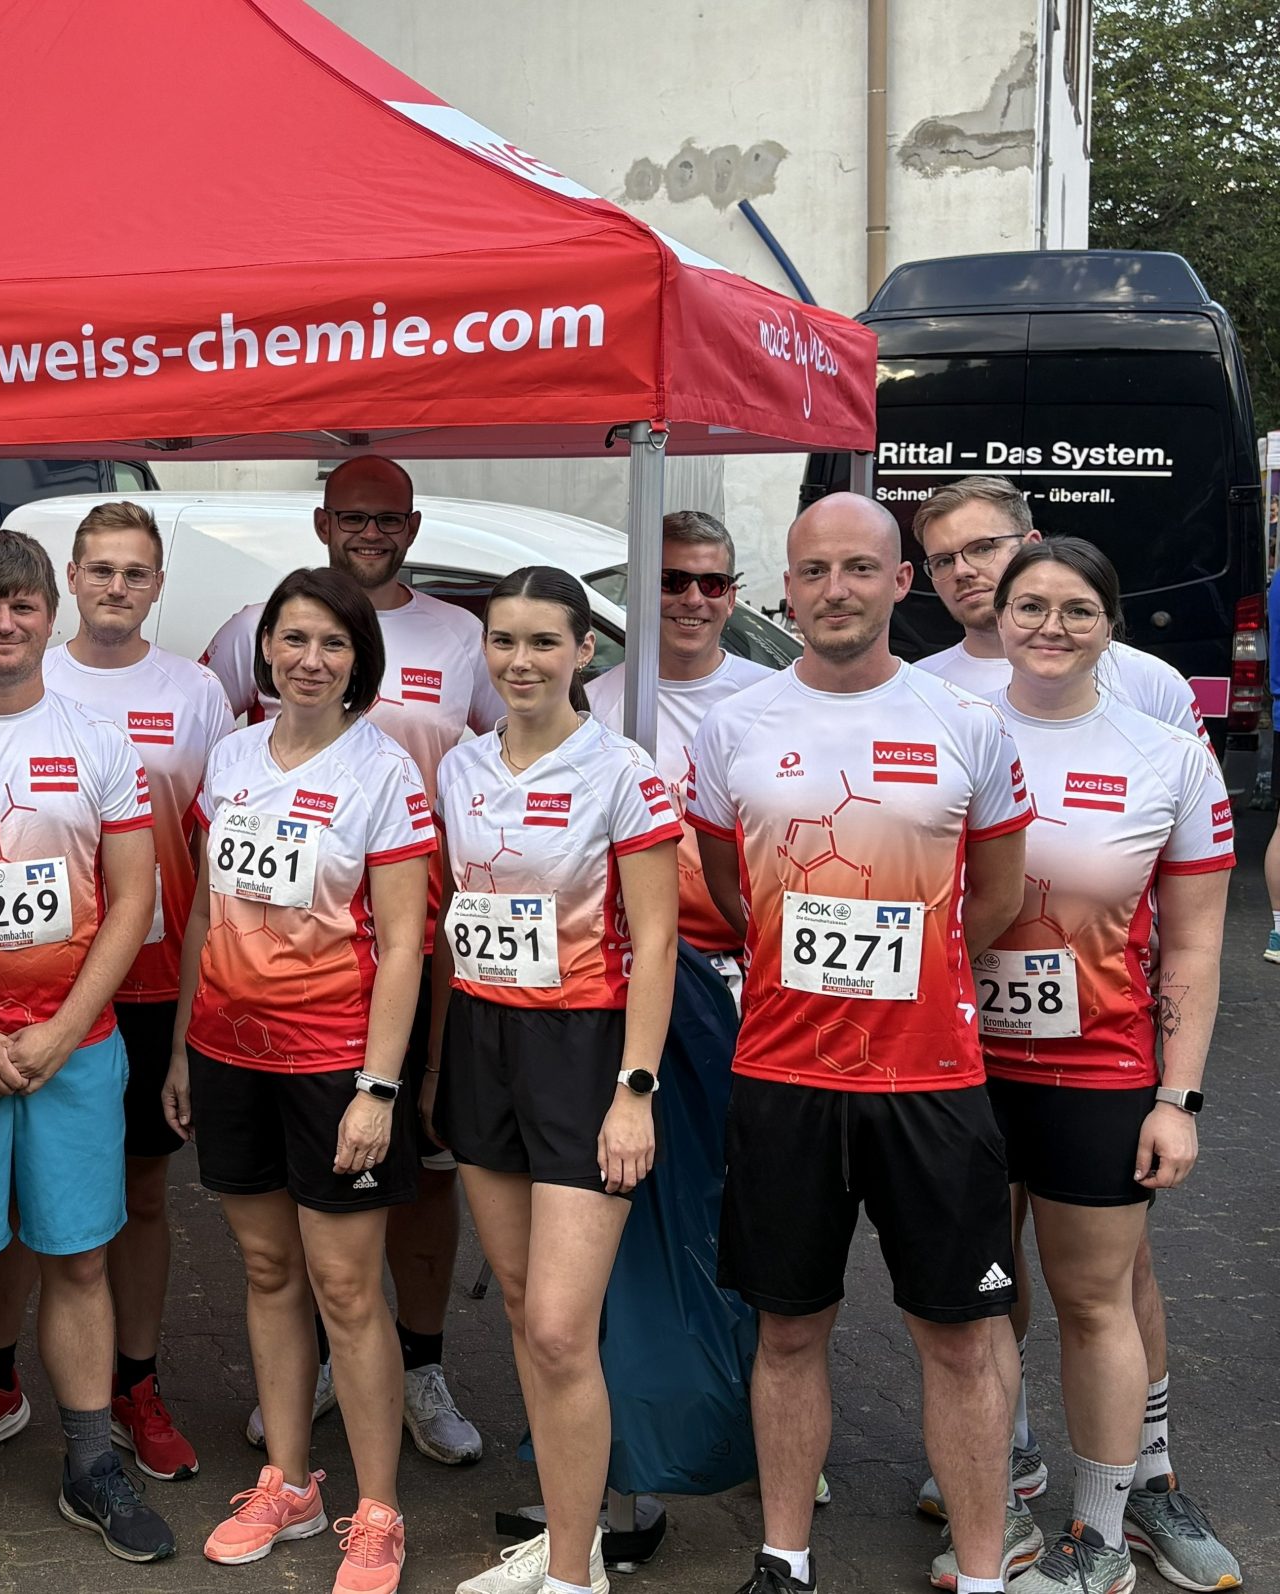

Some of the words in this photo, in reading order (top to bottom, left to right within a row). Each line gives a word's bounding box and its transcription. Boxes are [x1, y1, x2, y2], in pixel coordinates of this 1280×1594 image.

[759, 306, 791, 361] made
[789, 311, 811, 419] by
[878, 442, 953, 464] Rittal
[986, 442, 1042, 465] Das
[1052, 441, 1173, 469] System.
[1049, 488, 1115, 502] überall.
[403, 673, 440, 686] weiss
[129, 716, 172, 727] weiss
[875, 748, 935, 762] weiss
[31, 761, 76, 774] weiss
[776, 768, 804, 778] artiva
[1068, 779, 1125, 792] weiss
[295, 795, 335, 811] weiss
[528, 794, 569, 809] weiss
[226, 815, 247, 828] AOK
[218, 838, 299, 883] 8261
[236, 877, 272, 893] Krombacher
[457, 898, 478, 911] AOK
[798, 901, 832, 917] AOK
[454, 923, 540, 962] 8251
[793, 928, 903, 973] 8271
[478, 963, 517, 976] Krombacher
[823, 972, 875, 988] Krombacher
[979, 978, 1063, 1015] 258
[982, 1015, 1032, 1028] Krombacher
[978, 1277, 1012, 1292] adidas
